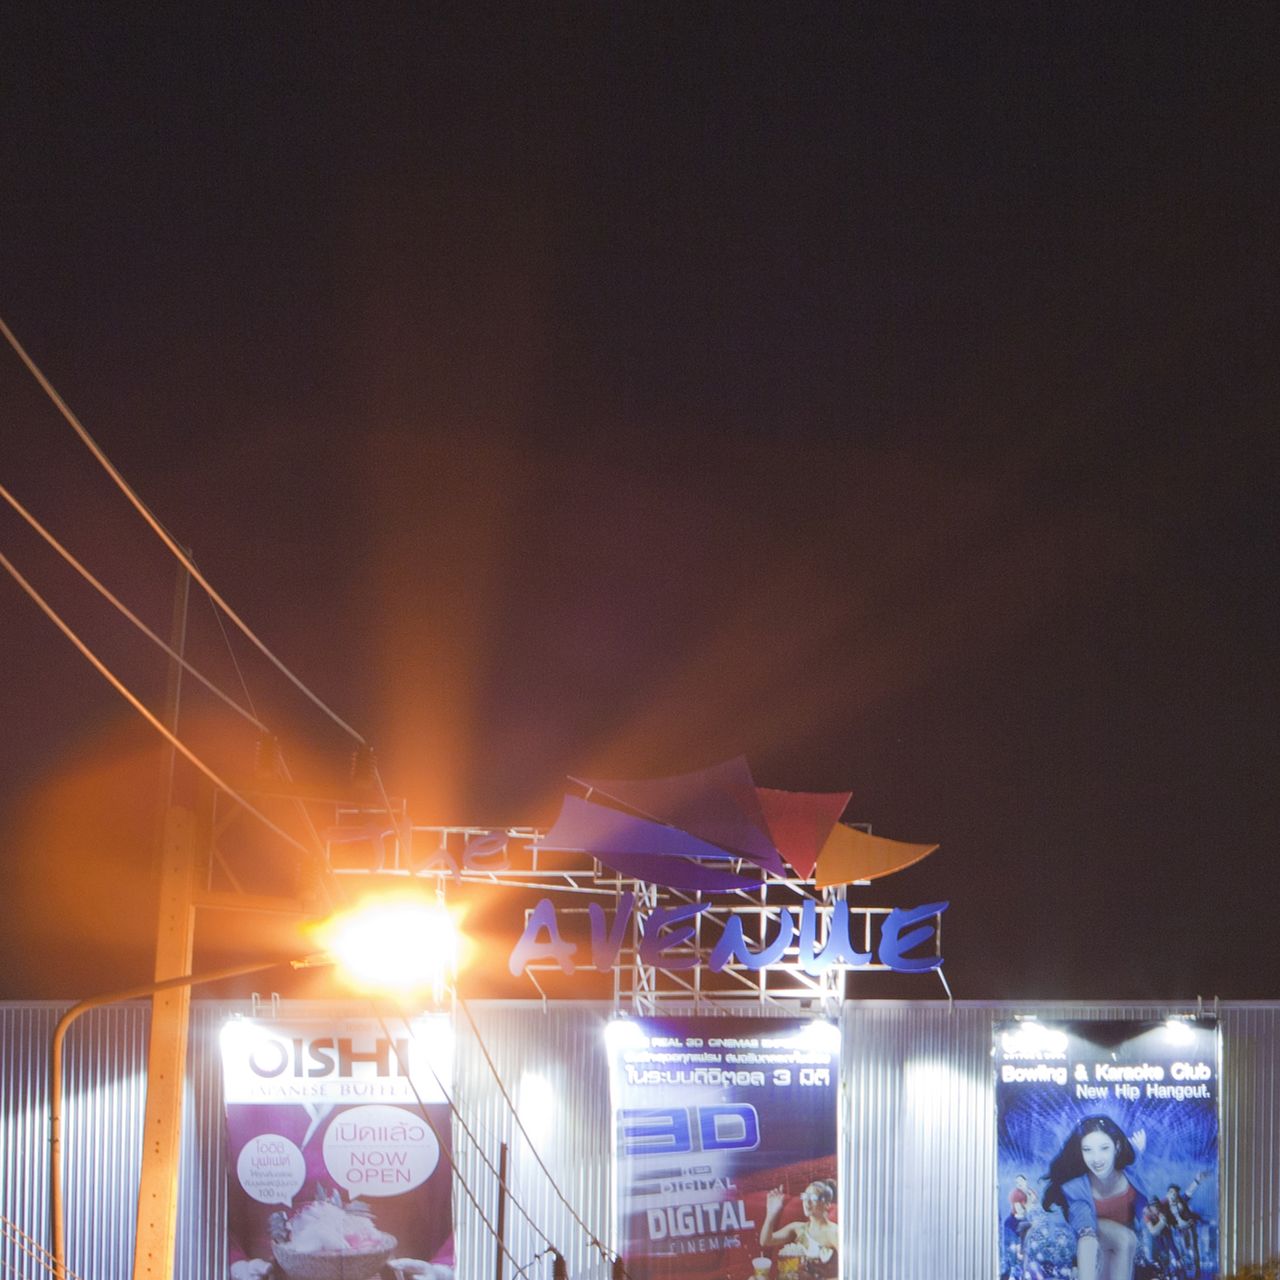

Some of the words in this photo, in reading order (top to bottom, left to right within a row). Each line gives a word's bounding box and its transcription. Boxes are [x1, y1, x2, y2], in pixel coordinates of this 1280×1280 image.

[250, 1038, 409, 1078] OISHI
[773, 1069, 791, 1086] 3
[1002, 1064, 1067, 1085] Bowling
[1074, 1064, 1088, 1081] &
[1096, 1063, 1164, 1082] Karaoke
[1171, 1062, 1211, 1080] Club
[1076, 1084, 1108, 1099] New
[1115, 1084, 1140, 1101] Hip
[1147, 1083, 1210, 1101] Hangout.
[335, 1122, 425, 1142] เปิดแล้ว
[618, 1103, 760, 1155] 3D
[350, 1152, 408, 1166] NOW
[346, 1168, 411, 1183] OPEN
[647, 1200, 755, 1240] DIGITAL
